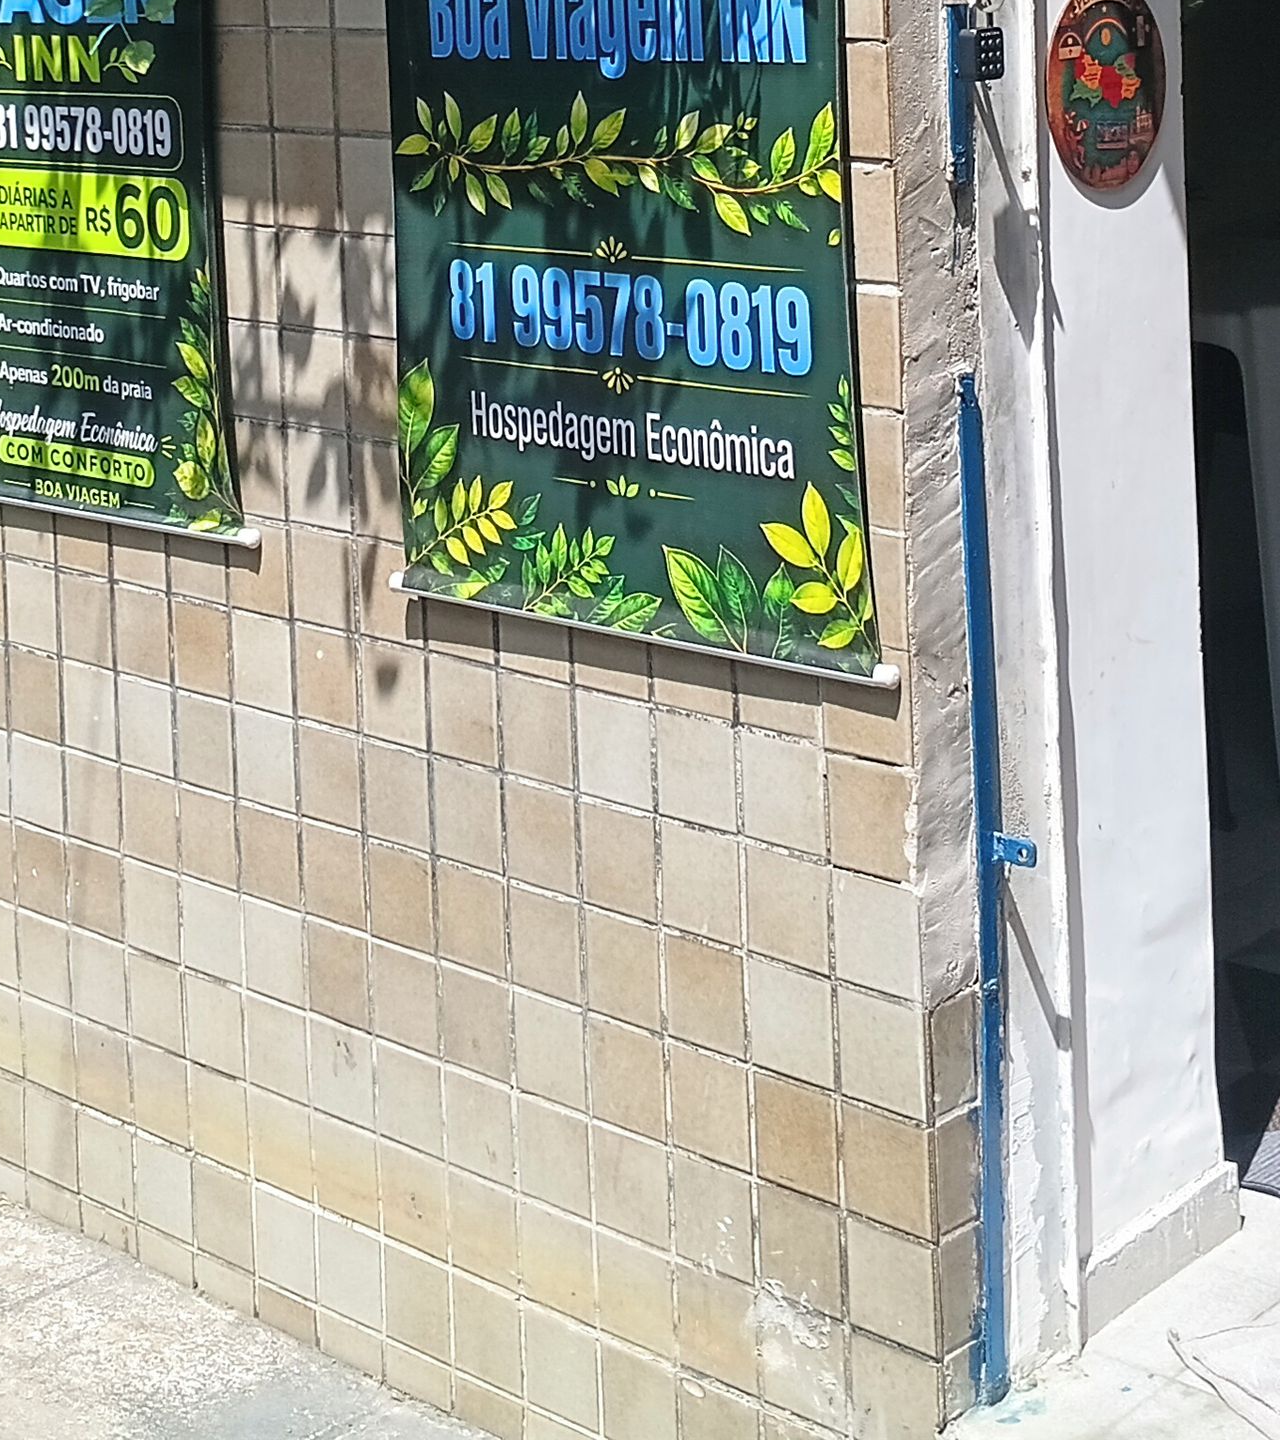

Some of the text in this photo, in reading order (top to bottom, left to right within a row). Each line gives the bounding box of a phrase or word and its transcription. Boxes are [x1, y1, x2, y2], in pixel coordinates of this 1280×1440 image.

[13, 34, 100, 82] INN
[24, 104, 171, 157] 99578-0819
[61, 189, 72, 209] A
[115, 183, 181, 253] 60
[58, 215, 77, 235] DE
[49, 276, 77, 291] com
[80, 274, 105, 297] TV,
[107, 276, 159, 302] frigobar
[448, 258, 812, 377] 81 99578-0819
[51, 364, 99, 391] 200m
[102, 375, 119, 394] da
[120, 380, 152, 400] praia
[80, 411, 157, 452] Econômica
[471, 390, 795, 480] Hospedagem Econômica
[5, 441, 146, 481] COM CONFORTO
[34, 478, 120, 508] BOA VIAGEM
